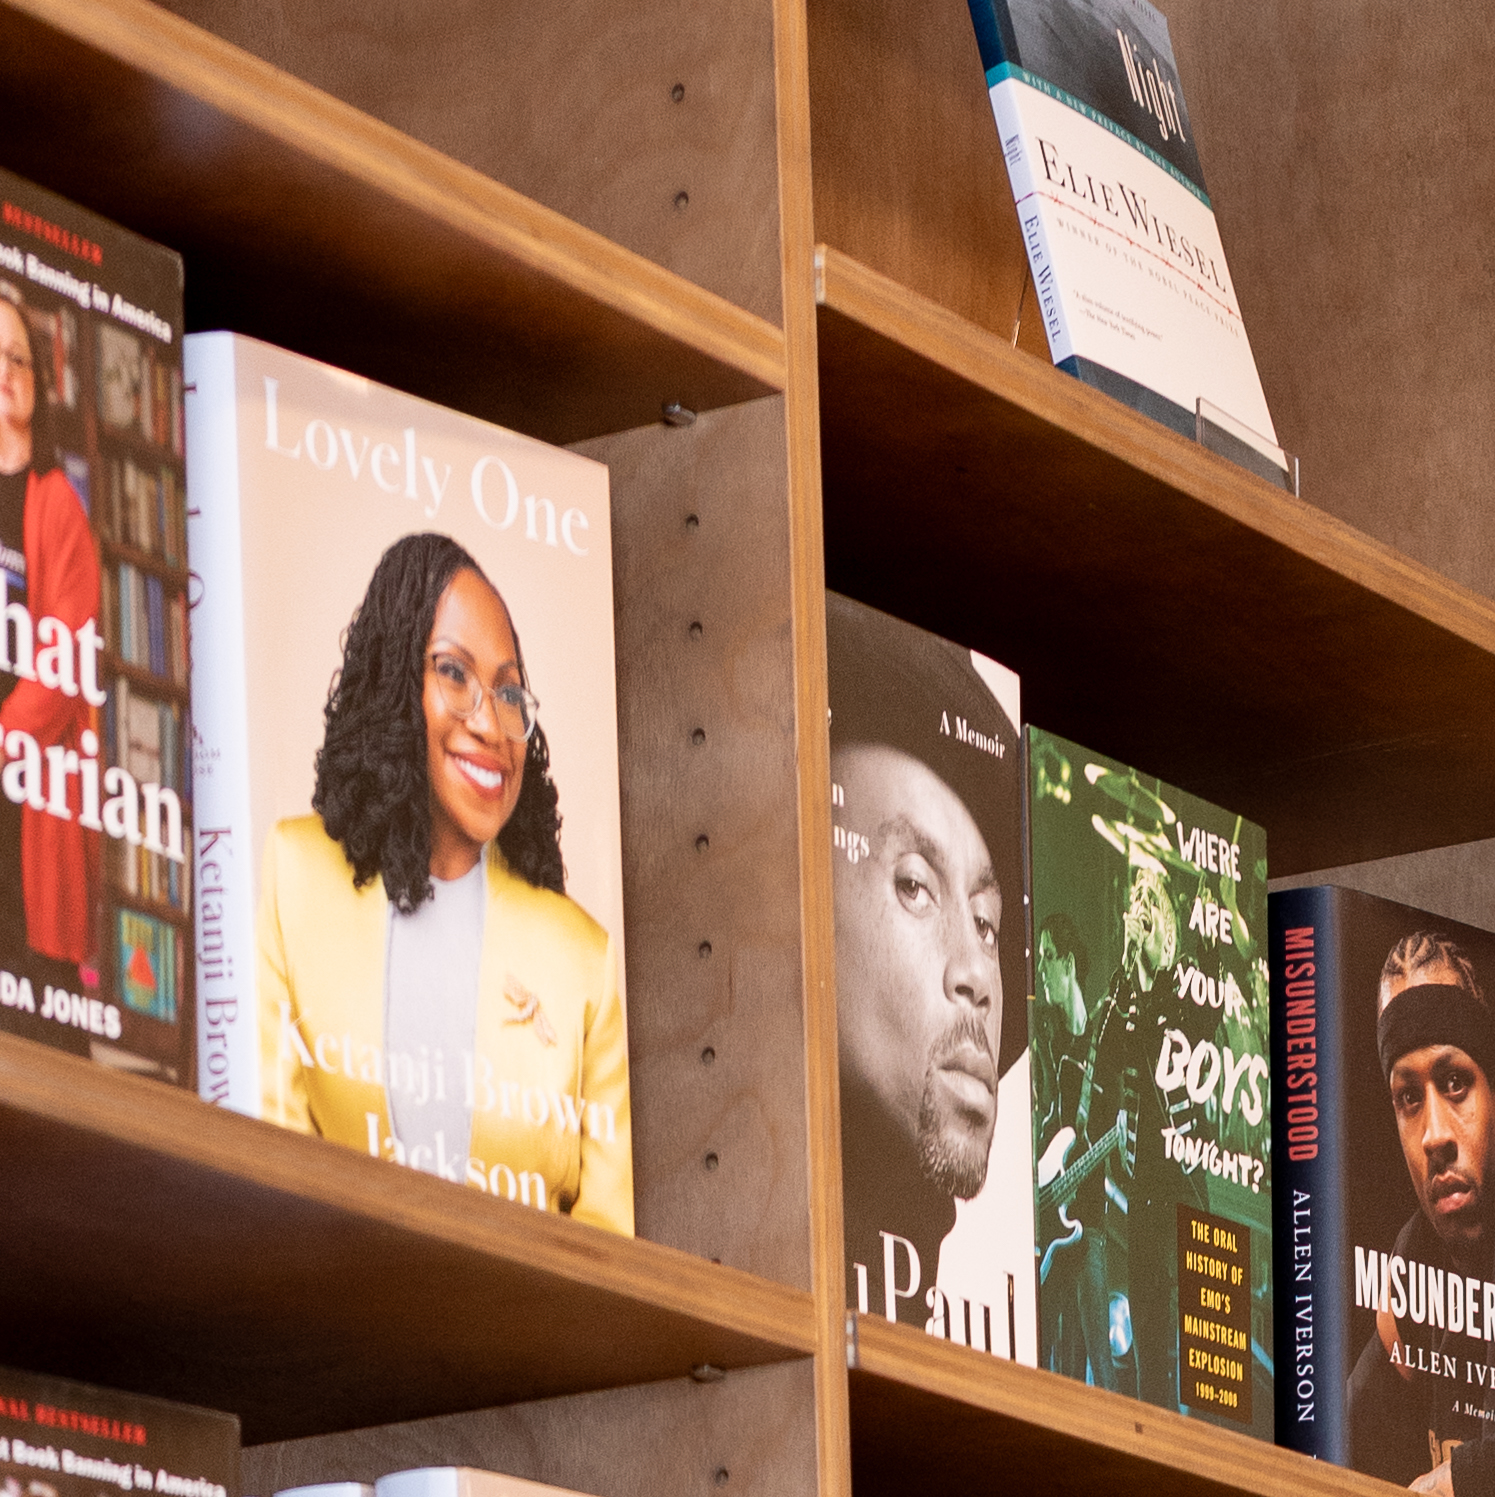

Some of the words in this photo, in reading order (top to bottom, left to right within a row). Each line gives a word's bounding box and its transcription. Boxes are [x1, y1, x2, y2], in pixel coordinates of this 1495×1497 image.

[1116, 28, 1186, 143] Night
[263, 377, 452, 520] Lovely
[470, 454, 592, 558] One
[939, 709, 951, 736] A
[955, 716, 1007, 760] Memoir
[1176, 821, 1243, 882] WHERE
[1188, 896, 1234, 945] ARE
[1176, 961, 1246, 1025] YOUR
[1155, 1028, 1269, 1128] BOYS
[1160, 1126, 1265, 1195] TONIGHT?
[1190, 1218, 1210, 1243] THE
[1213, 1226, 1238, 1254] ORAL
[1186, 1250, 1228, 1280] HISTORY
[1230, 1264, 1244, 1287] OF
[1183, 1314, 1248, 1352] MAINSTREAM
[1188, 1348, 1244, 1382] EXPLOSION
[1389, 1341, 1458, 1383] ALLEN
